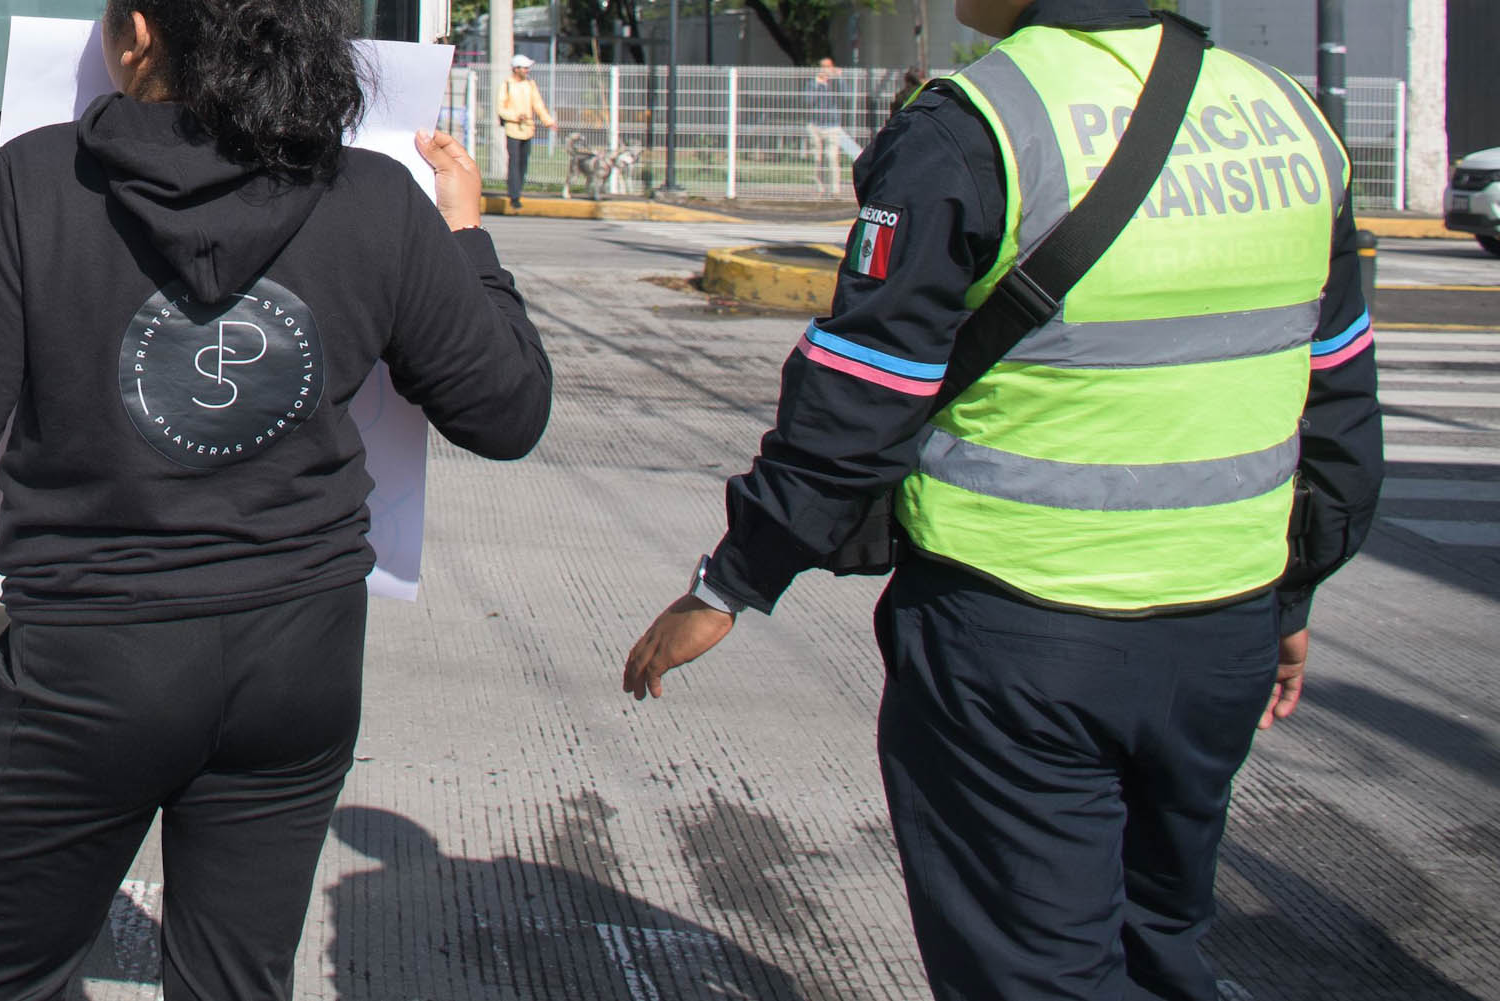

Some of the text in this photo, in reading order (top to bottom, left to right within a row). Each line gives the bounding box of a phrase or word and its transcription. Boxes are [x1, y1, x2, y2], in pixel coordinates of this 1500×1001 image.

[1086, 152, 1321, 219] ANSITO
[154, 300, 313, 456] PLAYERAS PERSONALIZADAS
